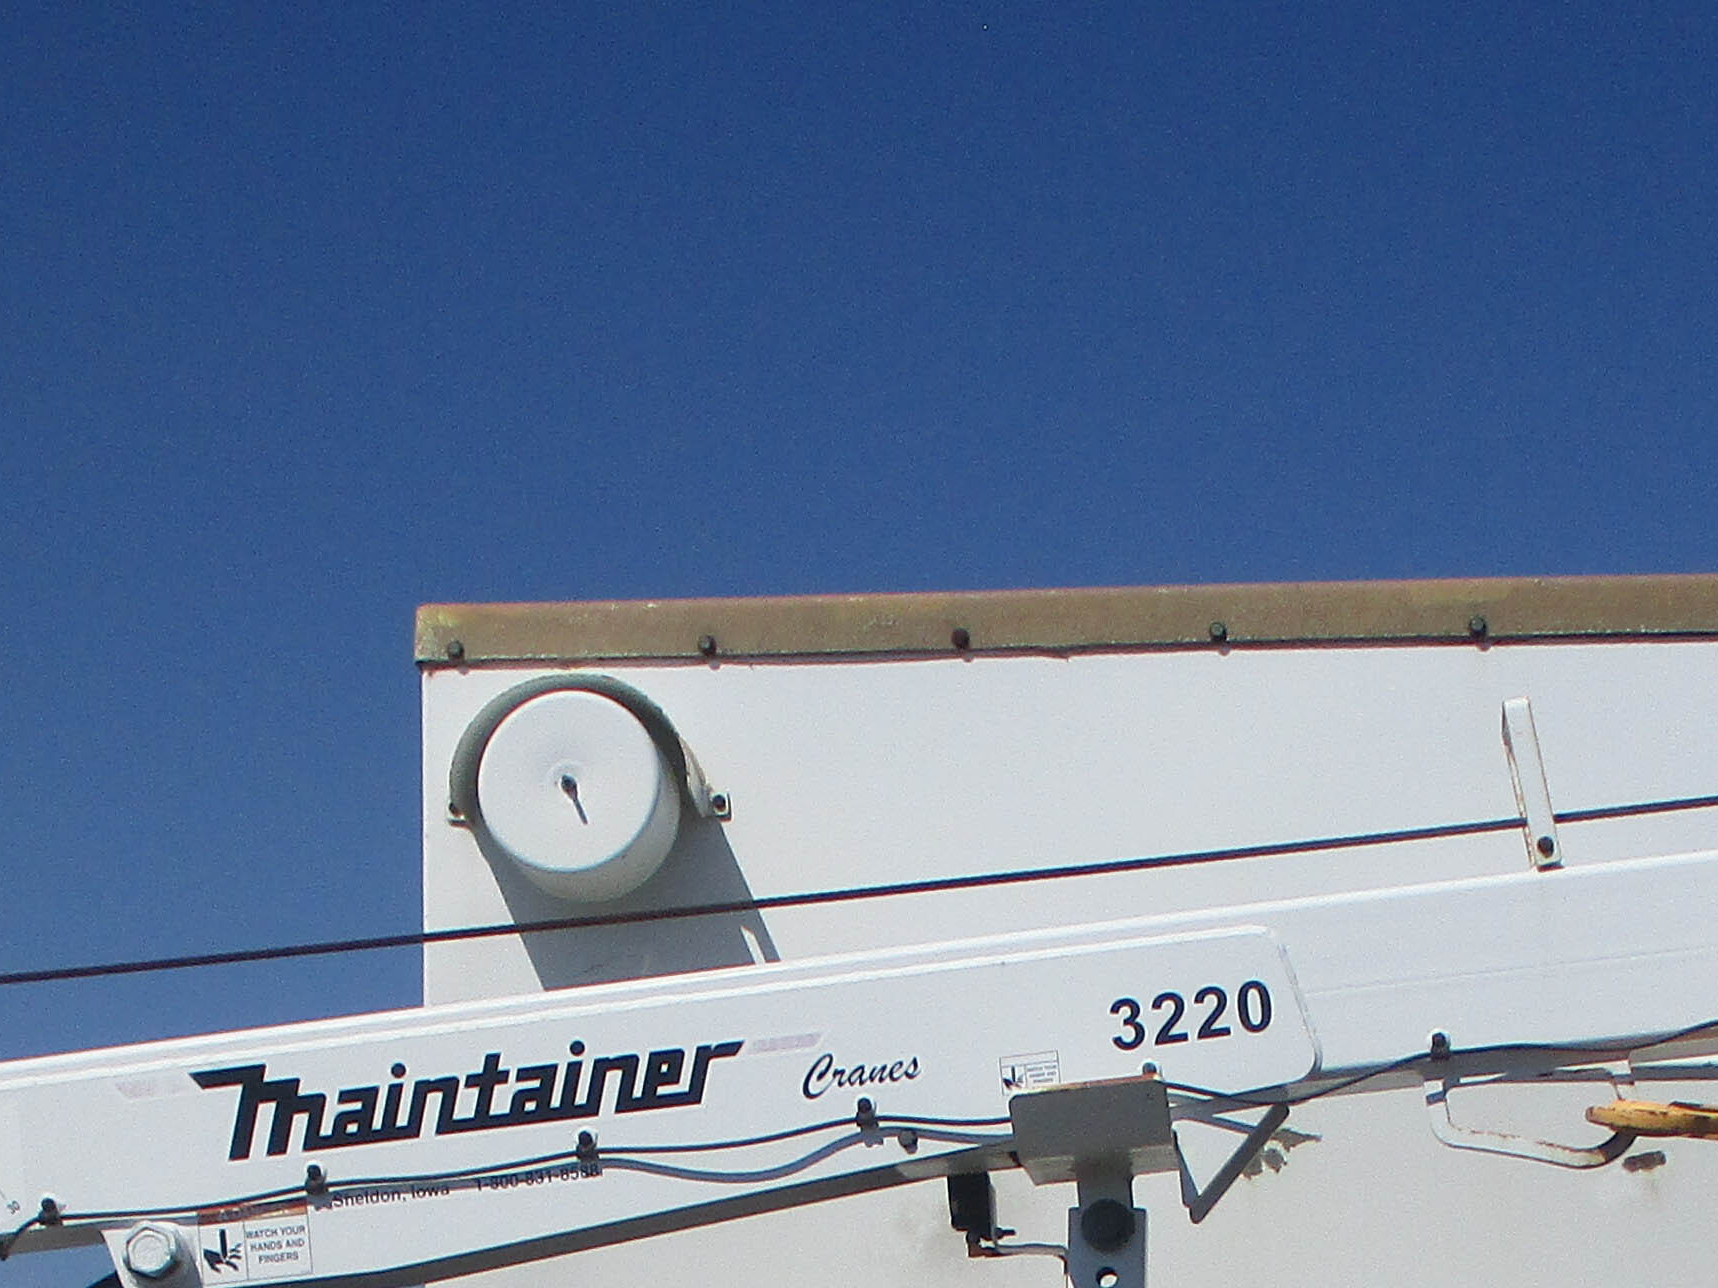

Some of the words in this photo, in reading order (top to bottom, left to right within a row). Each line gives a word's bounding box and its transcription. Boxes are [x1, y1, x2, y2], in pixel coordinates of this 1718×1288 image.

[1110, 980, 1273, 1051] 3220
[802, 1053, 922, 1100] Cranes
[188, 1040, 745, 1161] Maintainer
[7, 1200, 21, 1215] 30
[246, 1228, 278, 1240] WATCH
[280, 1225, 305, 1236] YOUR
[250, 1241, 282, 1253] HANDS
[286, 1238, 305, 1249] AND
[258, 1251, 299, 1265] FINGERS
